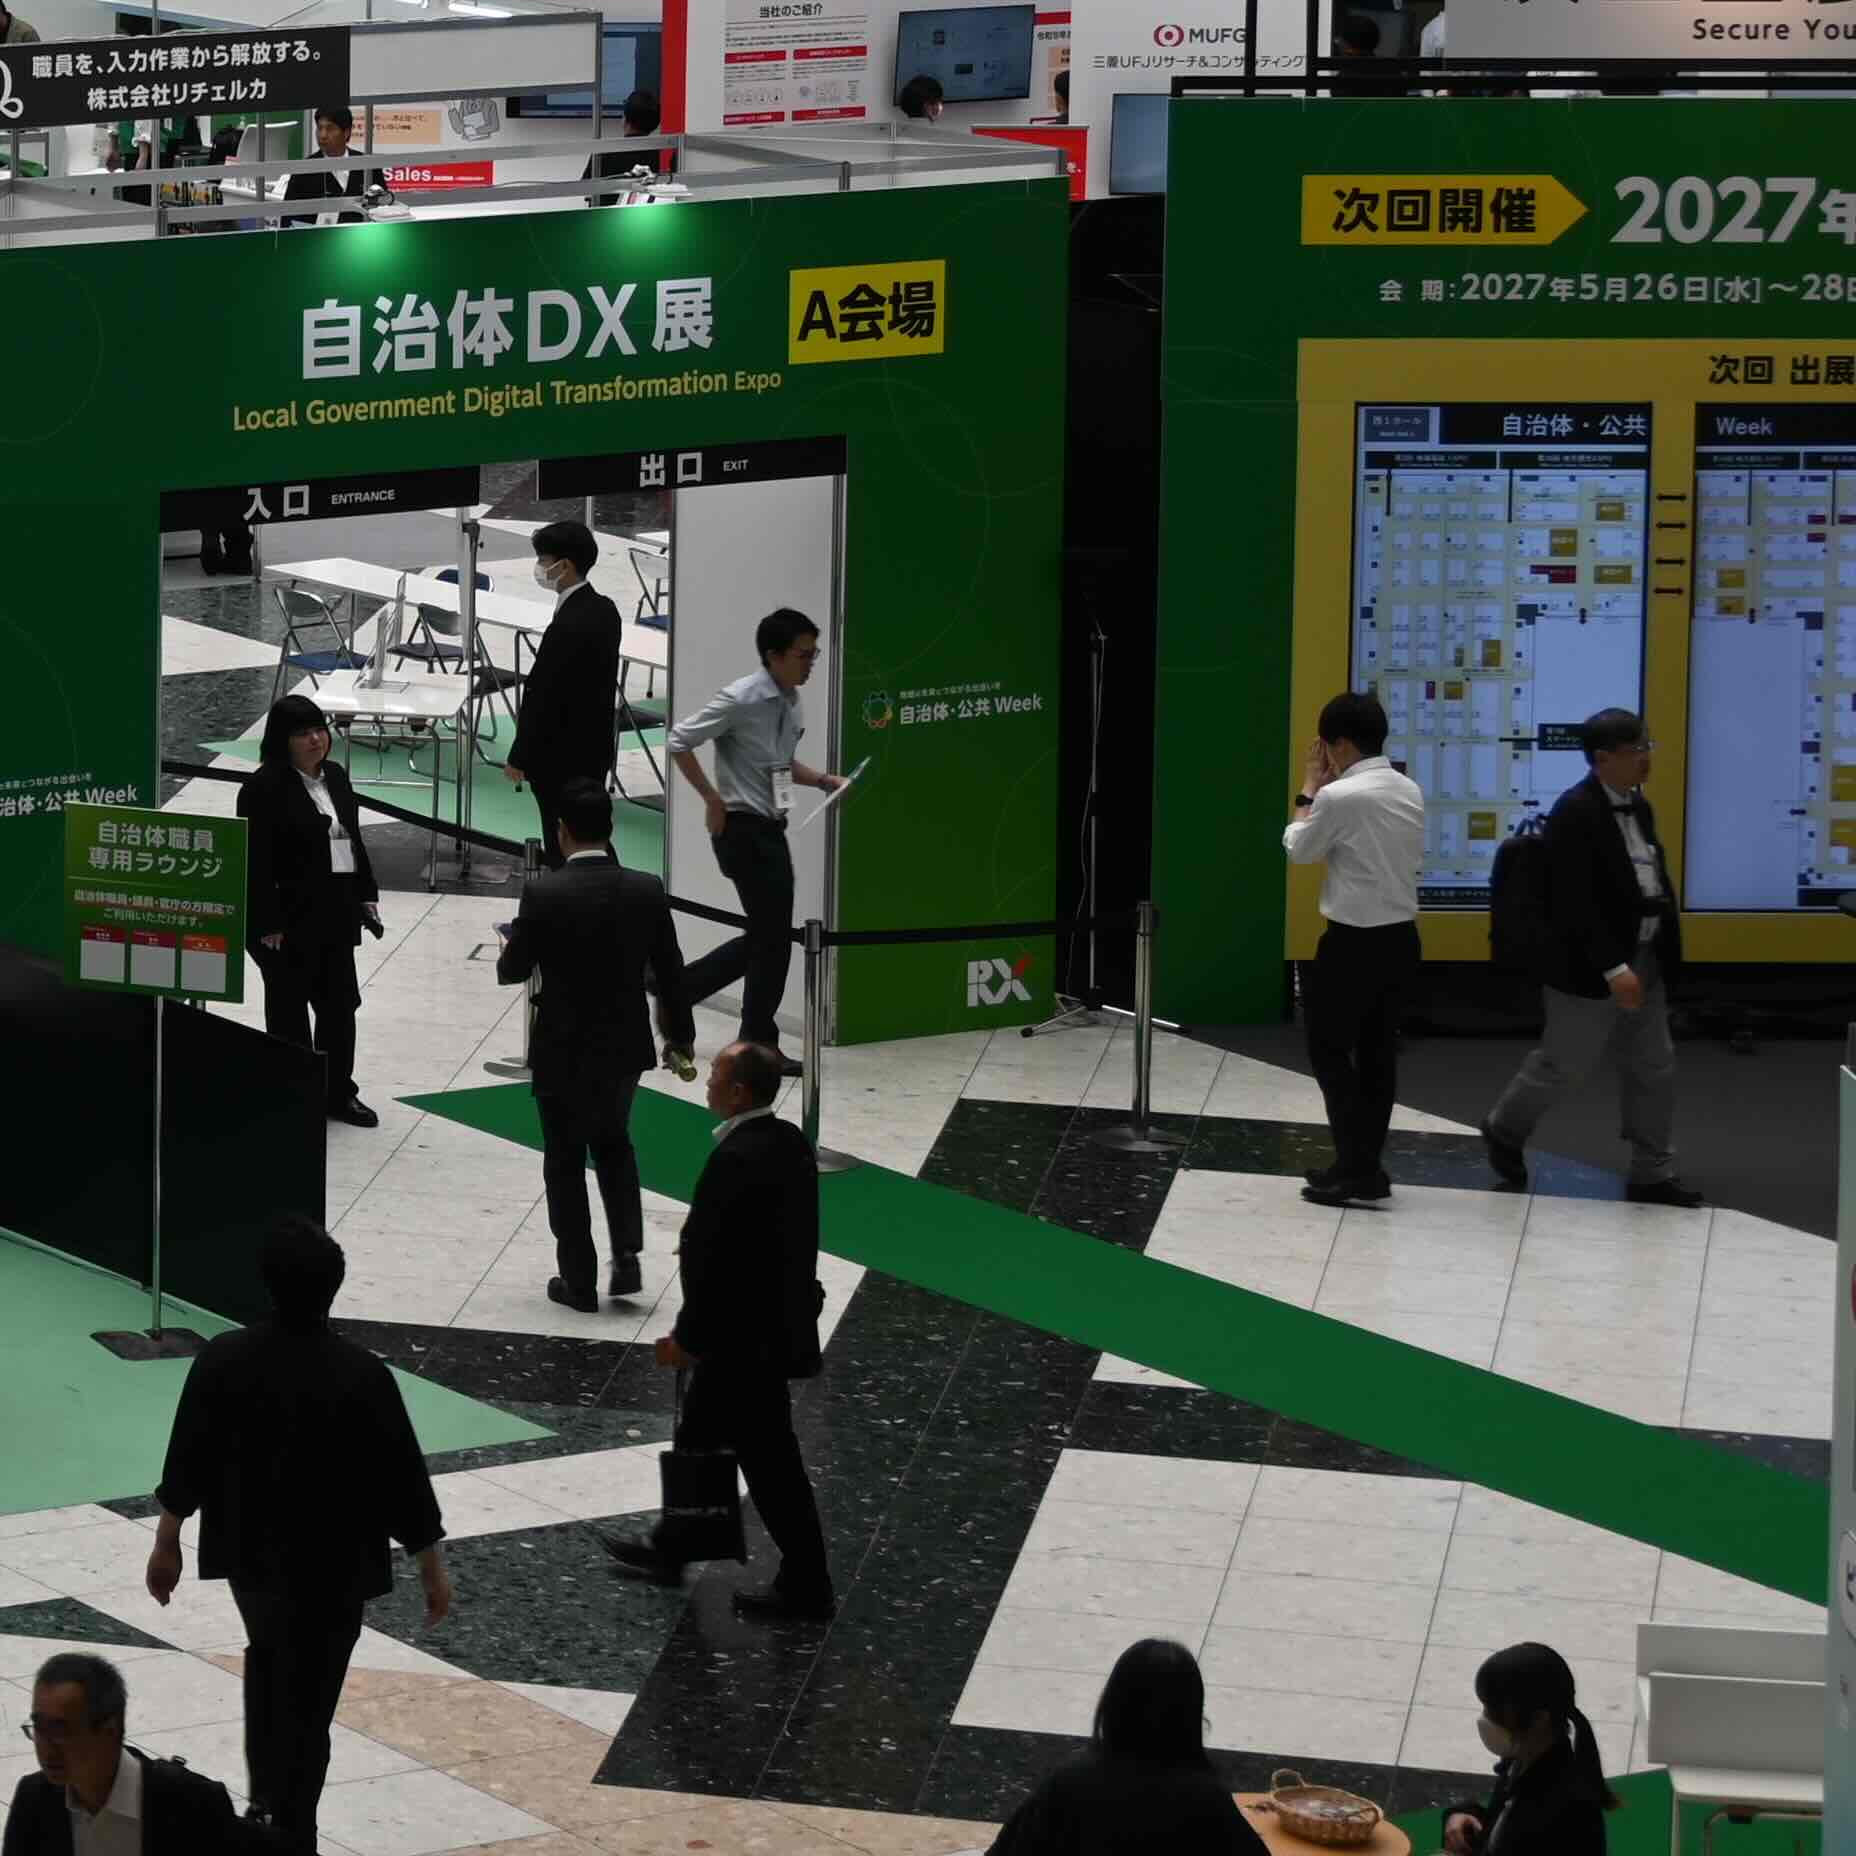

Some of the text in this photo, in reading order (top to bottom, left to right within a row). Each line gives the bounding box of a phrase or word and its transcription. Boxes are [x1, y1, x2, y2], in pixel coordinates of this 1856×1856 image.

[1189, 27, 1247, 44] MUFG
[1692, 17, 1791, 42] Secure
[30, 39, 324, 79] 職員を、入力作業から解放する。
[86, 76, 268, 112] 株式会社リチェルカ
[384, 167, 432, 182] Sales
[1330, 175, 1856, 247] 次回開催 2027年
[301, 272, 939, 382] 自治体DX展 A会場
[1706, 353, 1856, 388] 次回 出展
[233, 369, 783, 433] Local Government Digital Transformation Expo
[1500, 413, 1774, 440] 自治体・公共 Week
[638, 451, 750, 488] 出口 EXIT
[243, 484, 397, 523] 入口 ENTRANCE
[899, 693, 1043, 726] 自治体・公共 Week
[84, 783, 138, 803] Week
[97, 819, 215, 853] 自治体職員
[87, 846, 223, 878] 専用ラウンジ
[966, 952, 1032, 1010] RX
